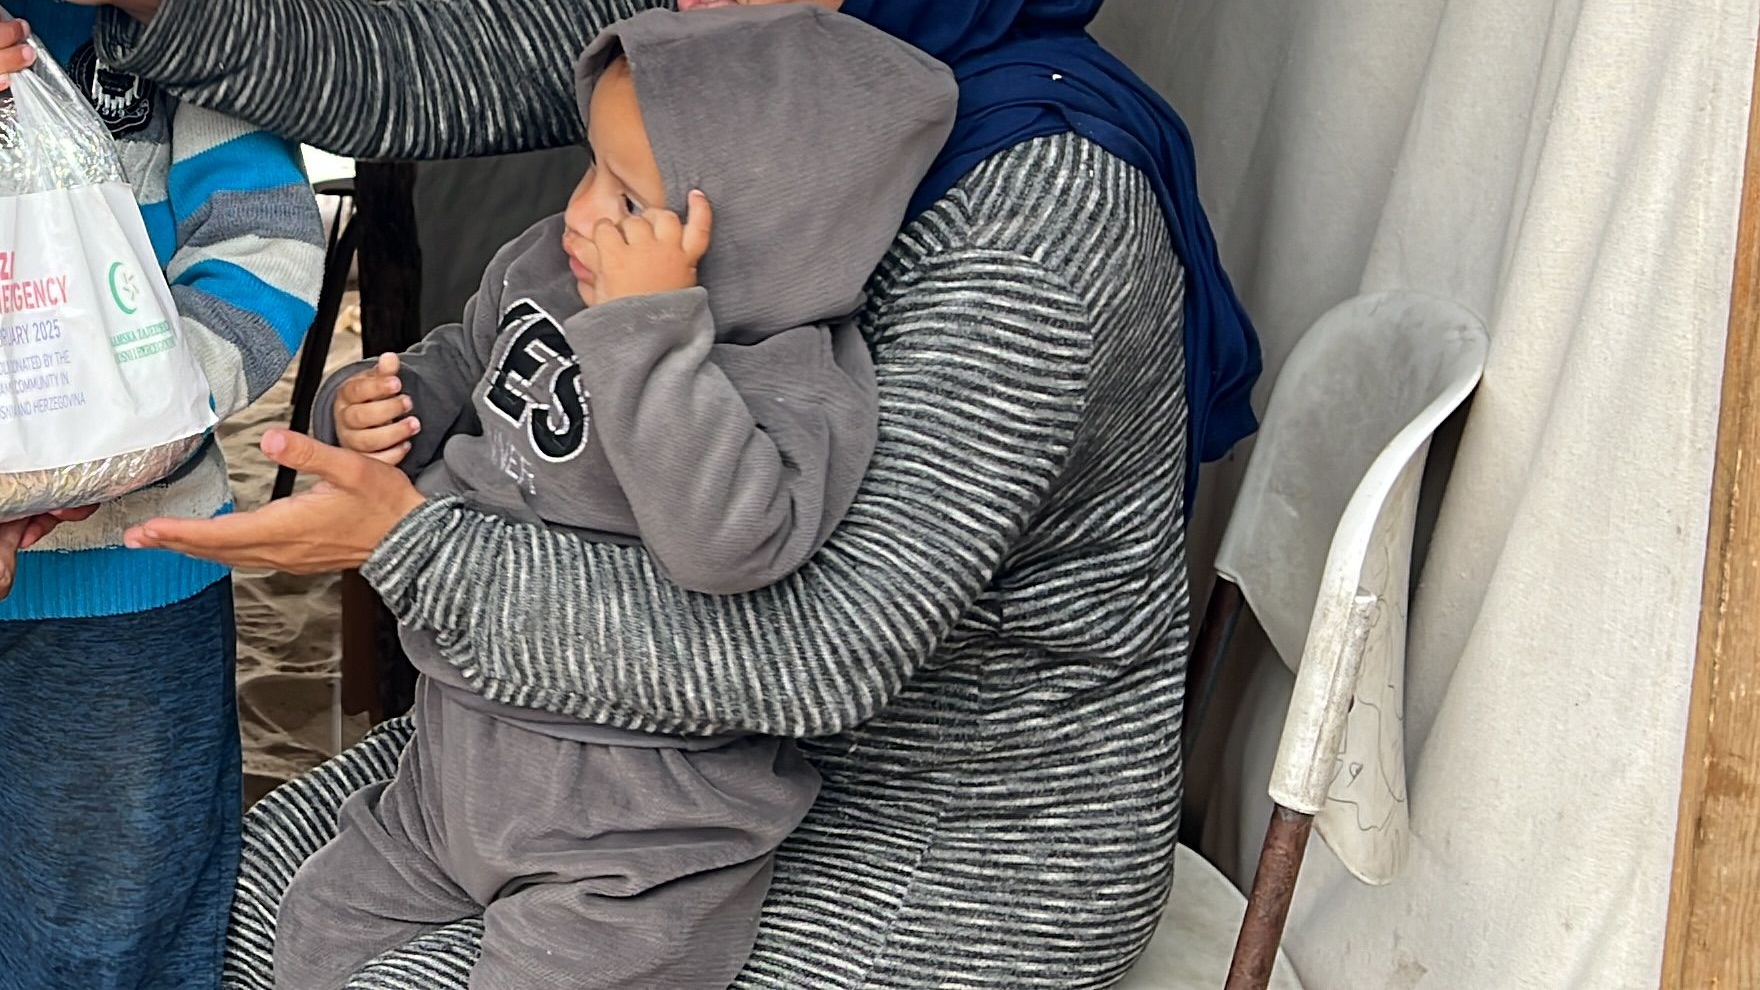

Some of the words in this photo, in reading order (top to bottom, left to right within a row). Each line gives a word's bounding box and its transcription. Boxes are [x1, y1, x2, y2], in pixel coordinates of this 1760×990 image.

[32, 318, 62, 342] 2025
[43, 352, 54, 368] BY
[54, 349, 72, 365] THE
